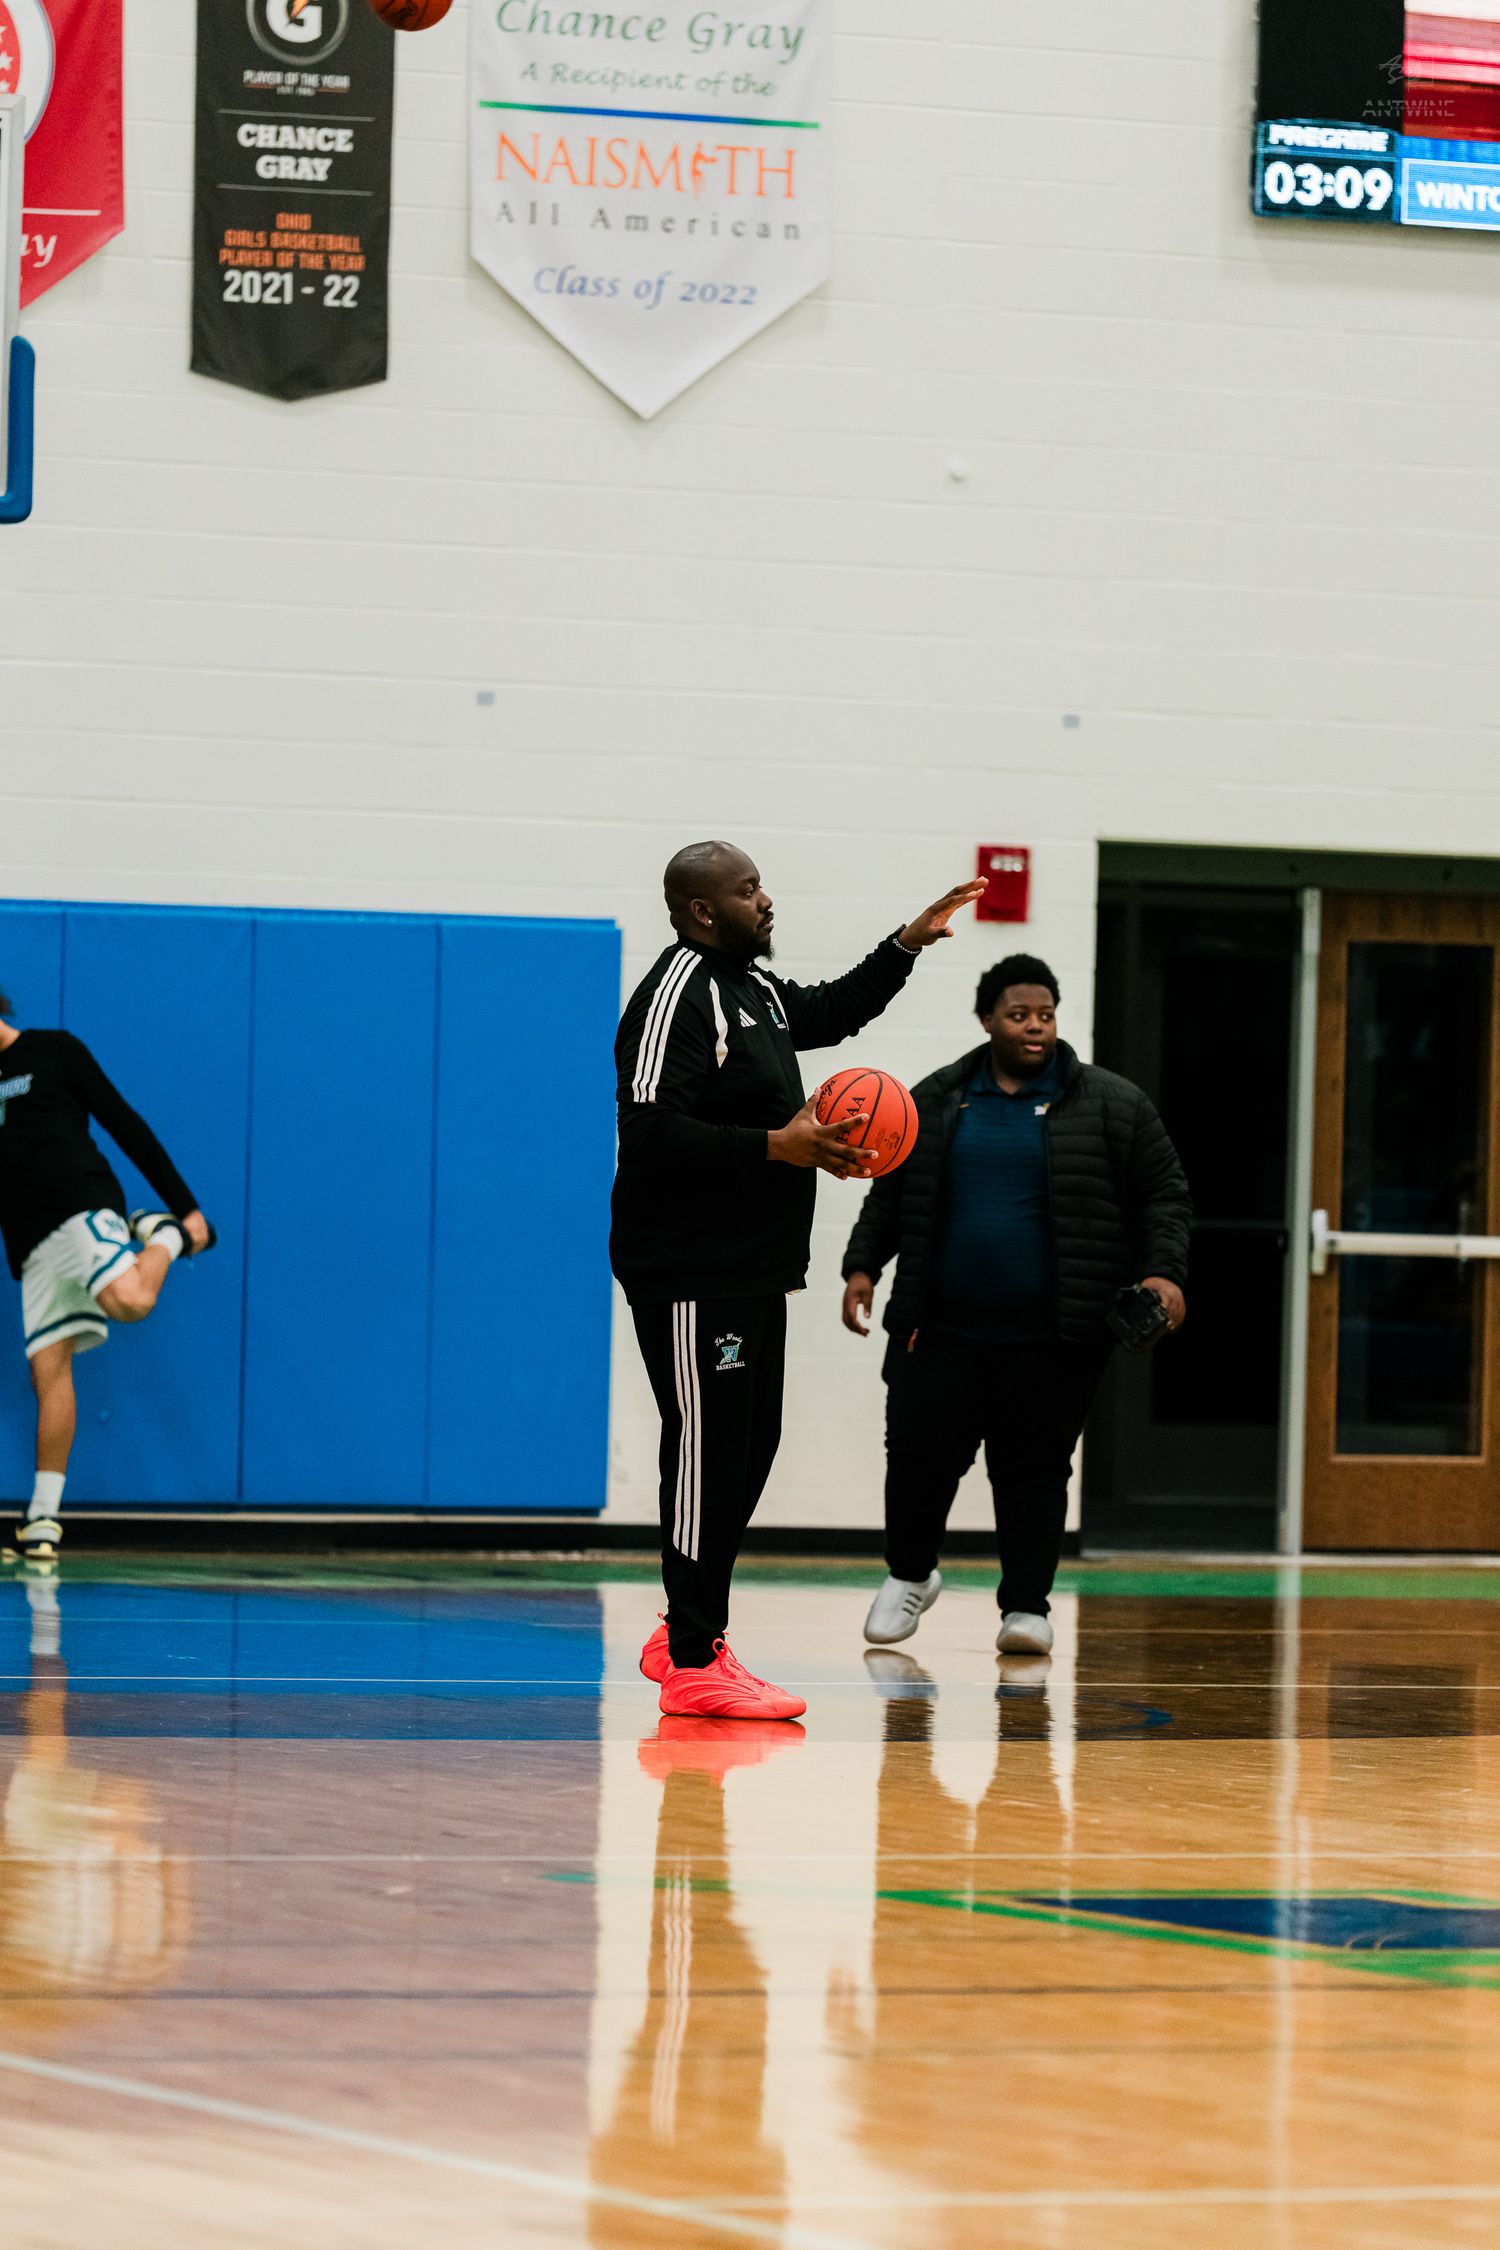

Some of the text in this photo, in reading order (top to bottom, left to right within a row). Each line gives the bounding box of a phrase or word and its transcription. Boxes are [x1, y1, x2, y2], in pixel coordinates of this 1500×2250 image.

[496, 0, 806, 65] Chance Gray
[243, 69, 284, 84] PLAYER
[320, 74, 351, 89] YEAR
[519, 61, 779, 97] A Recipient of the
[237, 123, 354, 152] CHANCE
[255, 154, 333, 181] GRAY
[494, 131, 799, 201] NAISMITH
[1264, 161, 1393, 211] 03:09
[275, 211, 312, 231] OHIO
[495, 200, 801, 241] All American
[223, 229, 362, 253] GIRLS BASKETBALL
[218, 247, 367, 272] PLAYER OF THE YEAR
[222, 269, 294, 305] 2021
[323, 274, 361, 308] 22
[533, 264, 759, 310] Class of 2022
